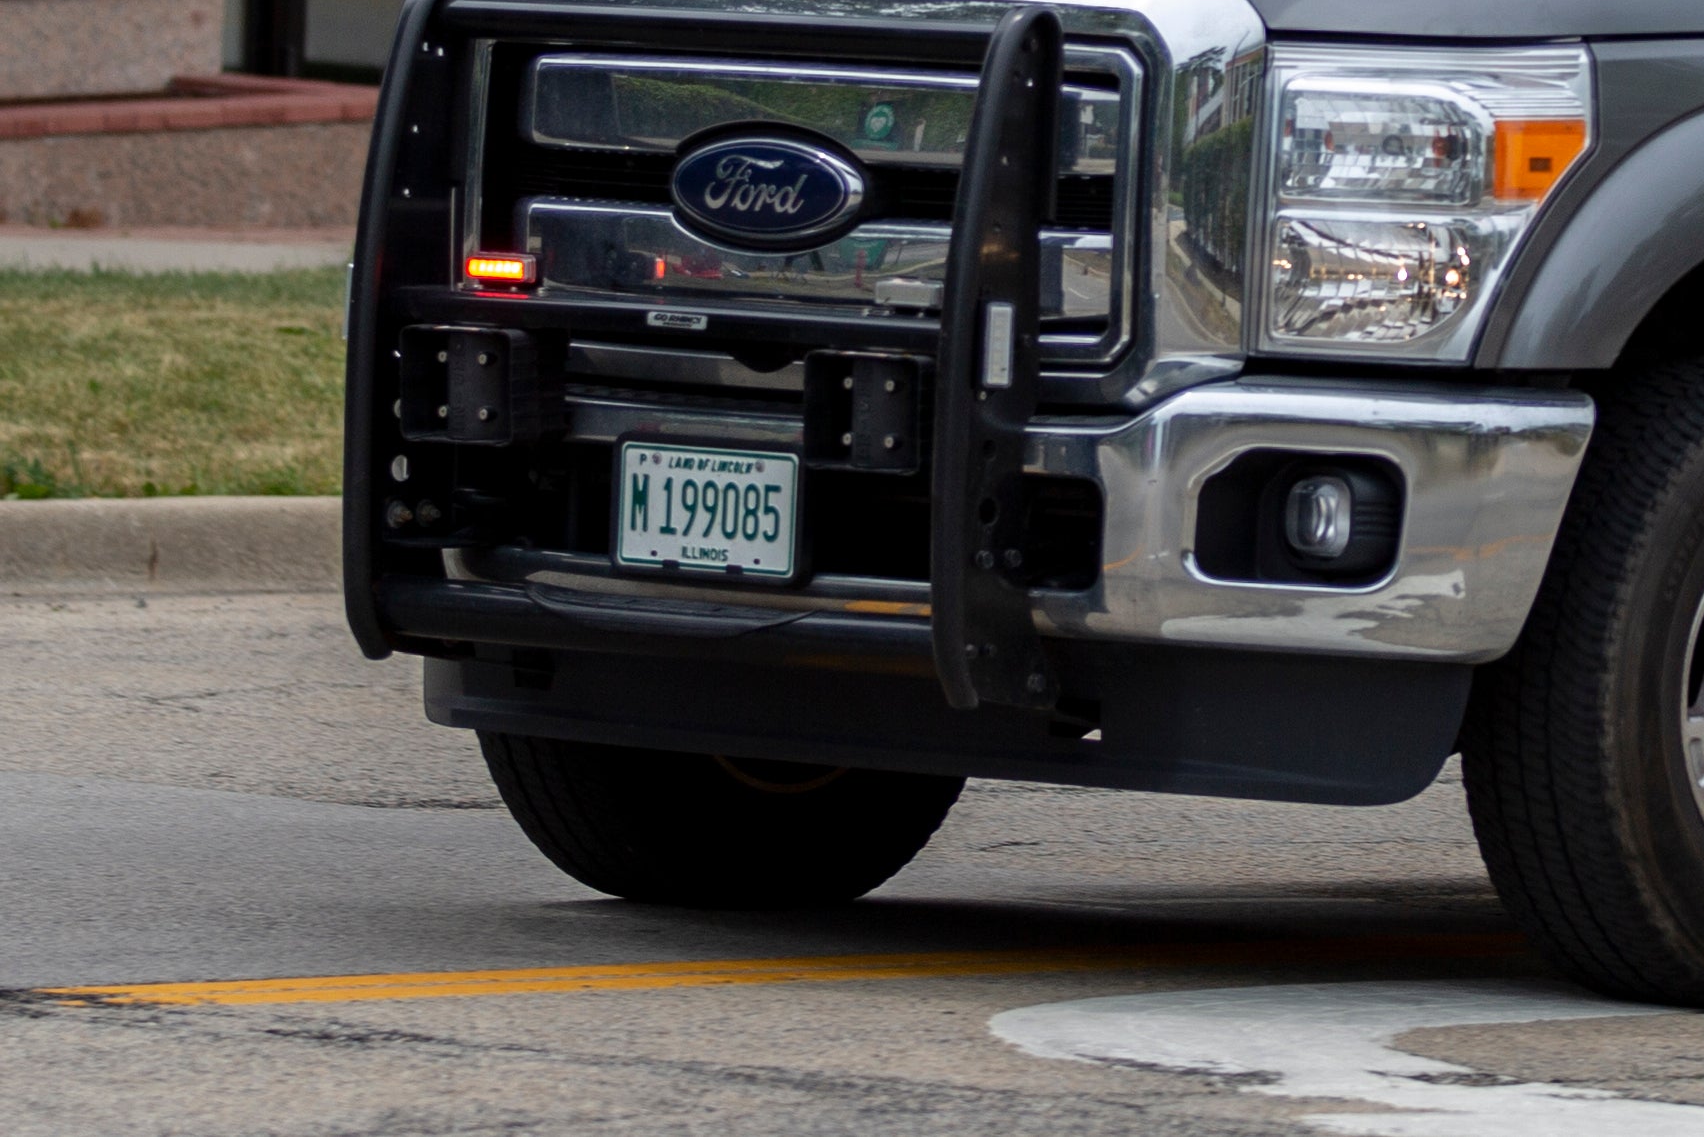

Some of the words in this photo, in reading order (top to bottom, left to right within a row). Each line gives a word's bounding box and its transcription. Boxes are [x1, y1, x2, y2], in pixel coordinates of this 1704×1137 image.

[703, 154, 809, 214] Ford
[668, 456, 696, 470] LAND
[697, 457, 710, 471] OF
[711, 459, 754, 475] LINCOLN
[629, 472, 650, 533] M
[659, 476, 783, 544] 199085
[680, 546, 730, 563] ILLINOIS
